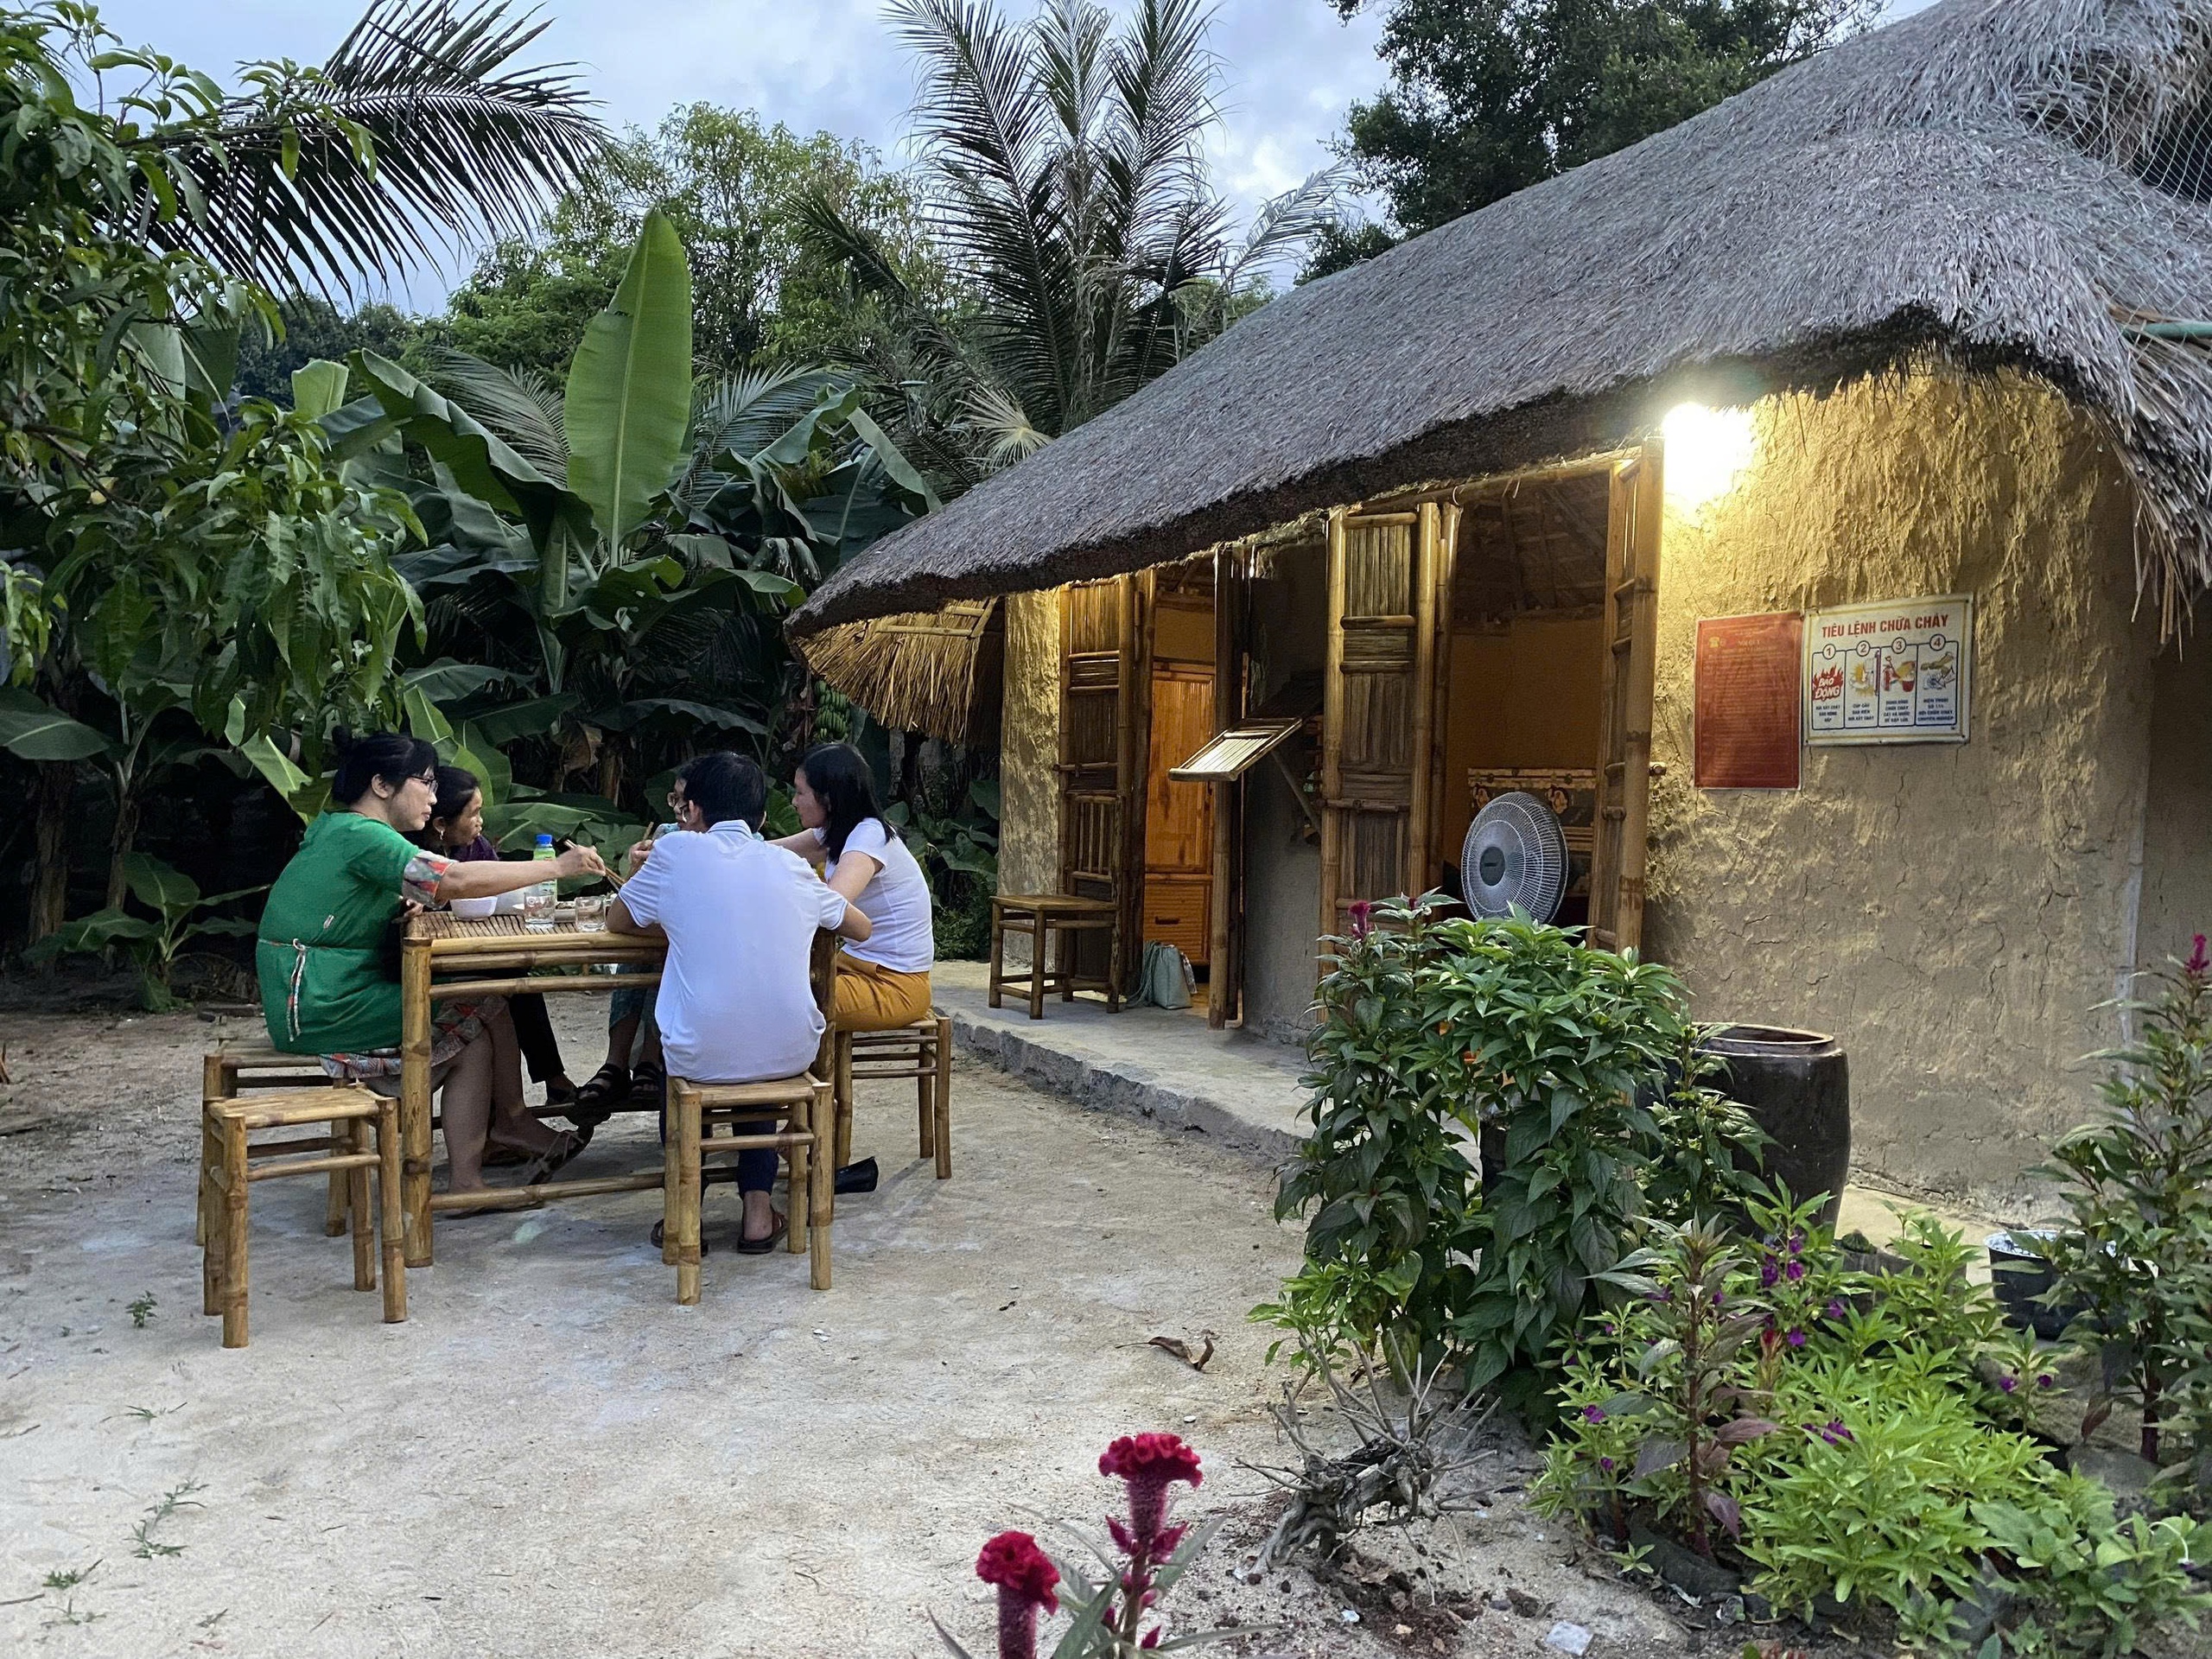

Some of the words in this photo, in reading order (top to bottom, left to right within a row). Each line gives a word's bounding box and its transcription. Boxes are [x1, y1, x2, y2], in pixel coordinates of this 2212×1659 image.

[1822, 622, 1844, 638] TIÊU
[1848, 620, 1876, 638] LỆNH
[1880, 615, 1910, 632] CHỮA
[1915, 613, 1948, 629] CHÁY
[1896, 641, 1903, 650] 3
[1934, 638, 1941, 646] 4
